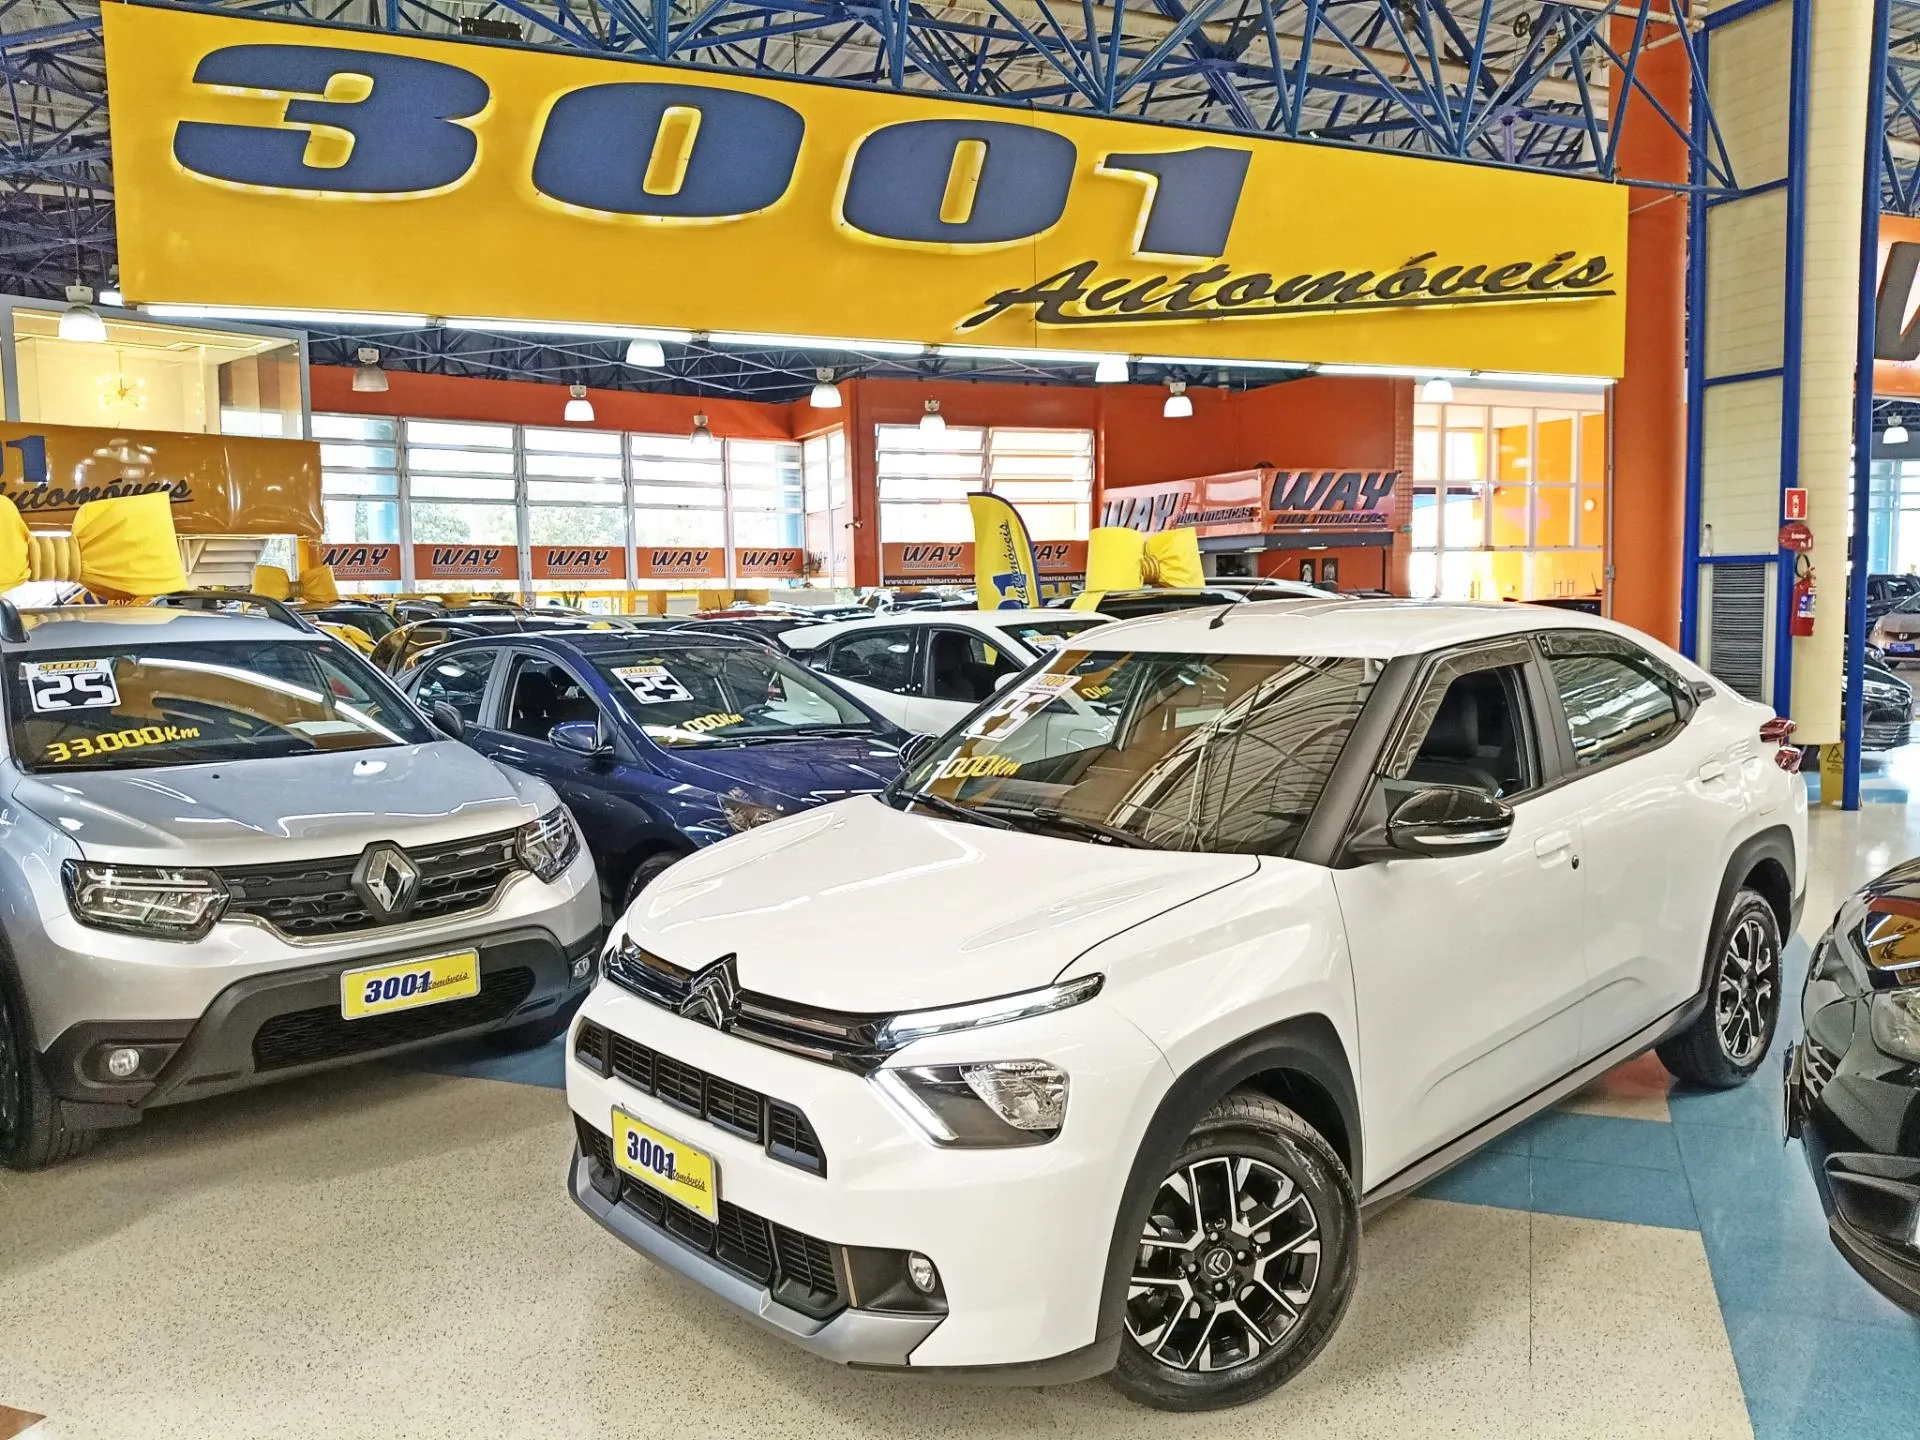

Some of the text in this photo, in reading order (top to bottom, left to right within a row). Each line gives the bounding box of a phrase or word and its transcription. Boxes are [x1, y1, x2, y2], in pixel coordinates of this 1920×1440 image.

[174, 44, 1252, 257] 3001
[957, 251, 1614, 329] Automóveis
[0, 478, 194, 512] utomóveis
[1269, 472, 1397, 511] WAY
[1101, 493, 1179, 532] WAY
[431, 548, 501, 567] WAY
[547, 549, 610, 566] WAY
[651, 550, 710, 566] WAY
[742, 551, 796, 566] WAY
[903, 546, 963, 562] WAY
[884, 577, 976, 586] www.waymultimarcas.com.
[36, 674, 115, 709] 25
[626, 675, 690, 701] 25
[364, 971, 431, 1003] 3001
[627, 1131, 674, 1180] 3001
